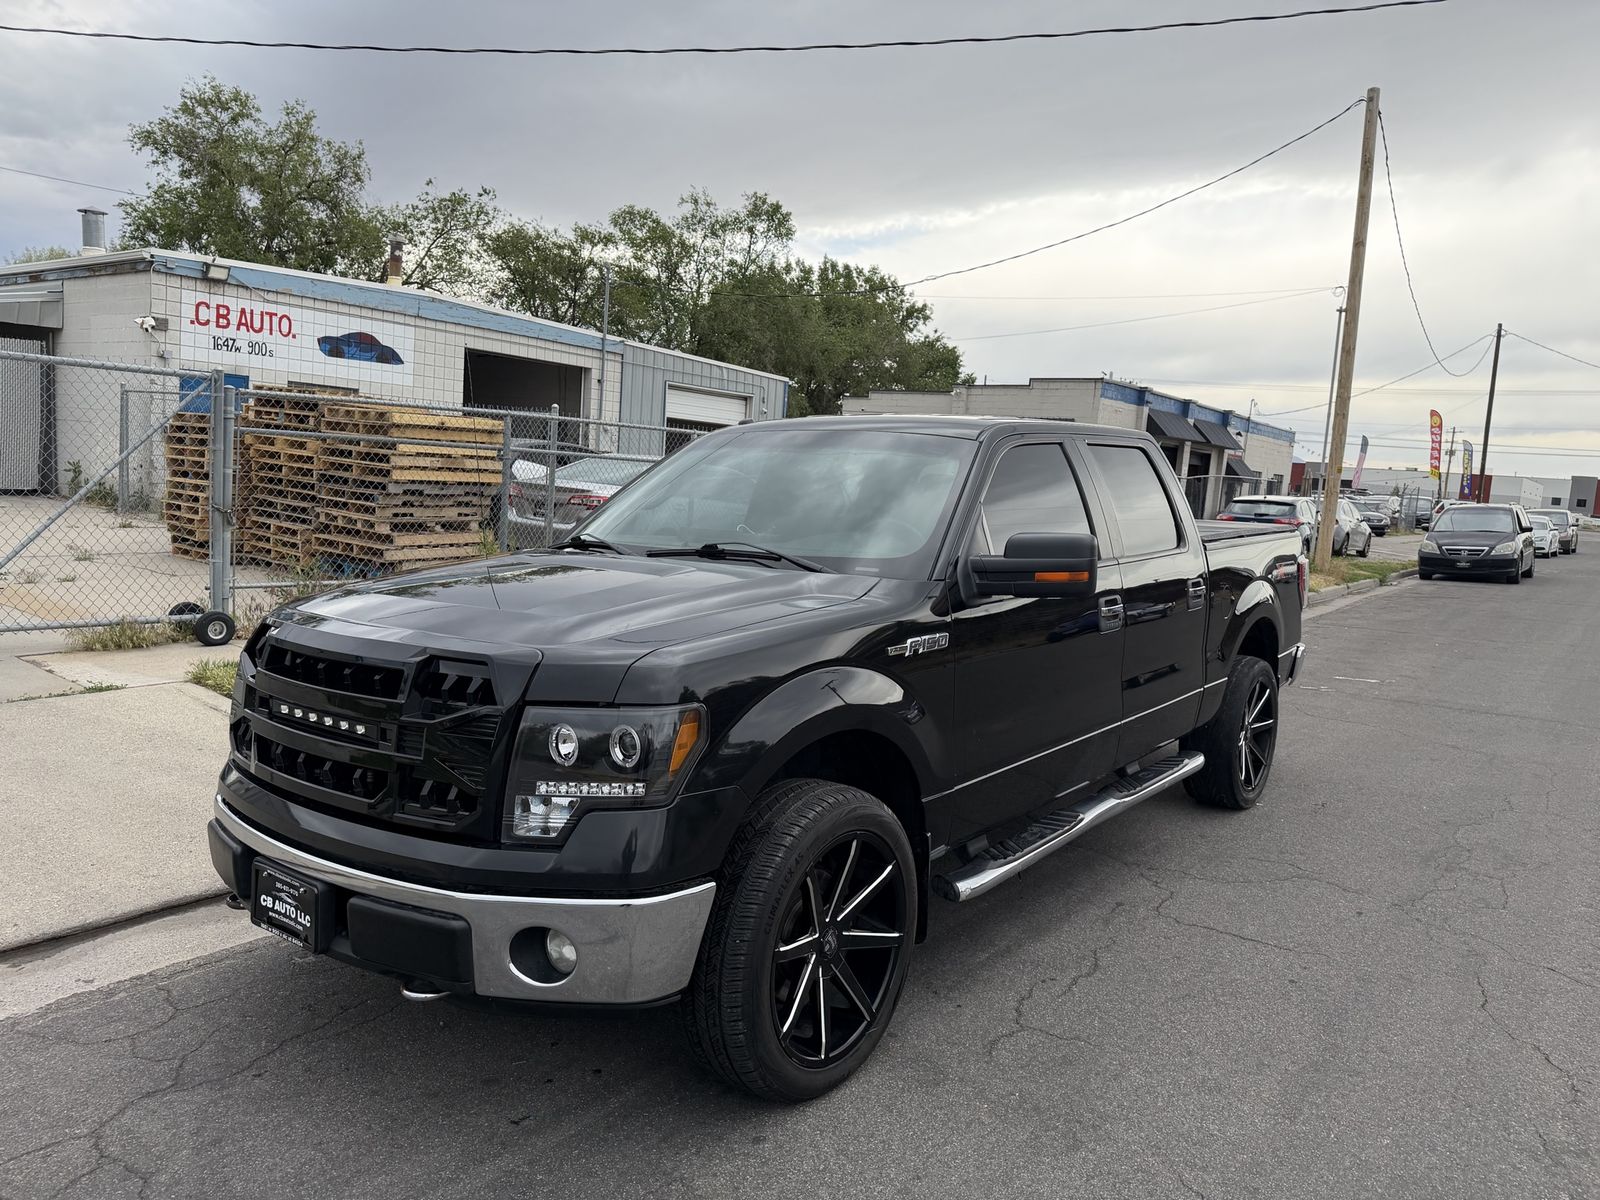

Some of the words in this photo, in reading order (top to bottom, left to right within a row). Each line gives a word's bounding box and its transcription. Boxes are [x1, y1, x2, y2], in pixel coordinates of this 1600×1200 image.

[260, 894, 273, 908] CB
[274, 900, 296, 918] AUTO
[297, 909, 311, 928] LLC
